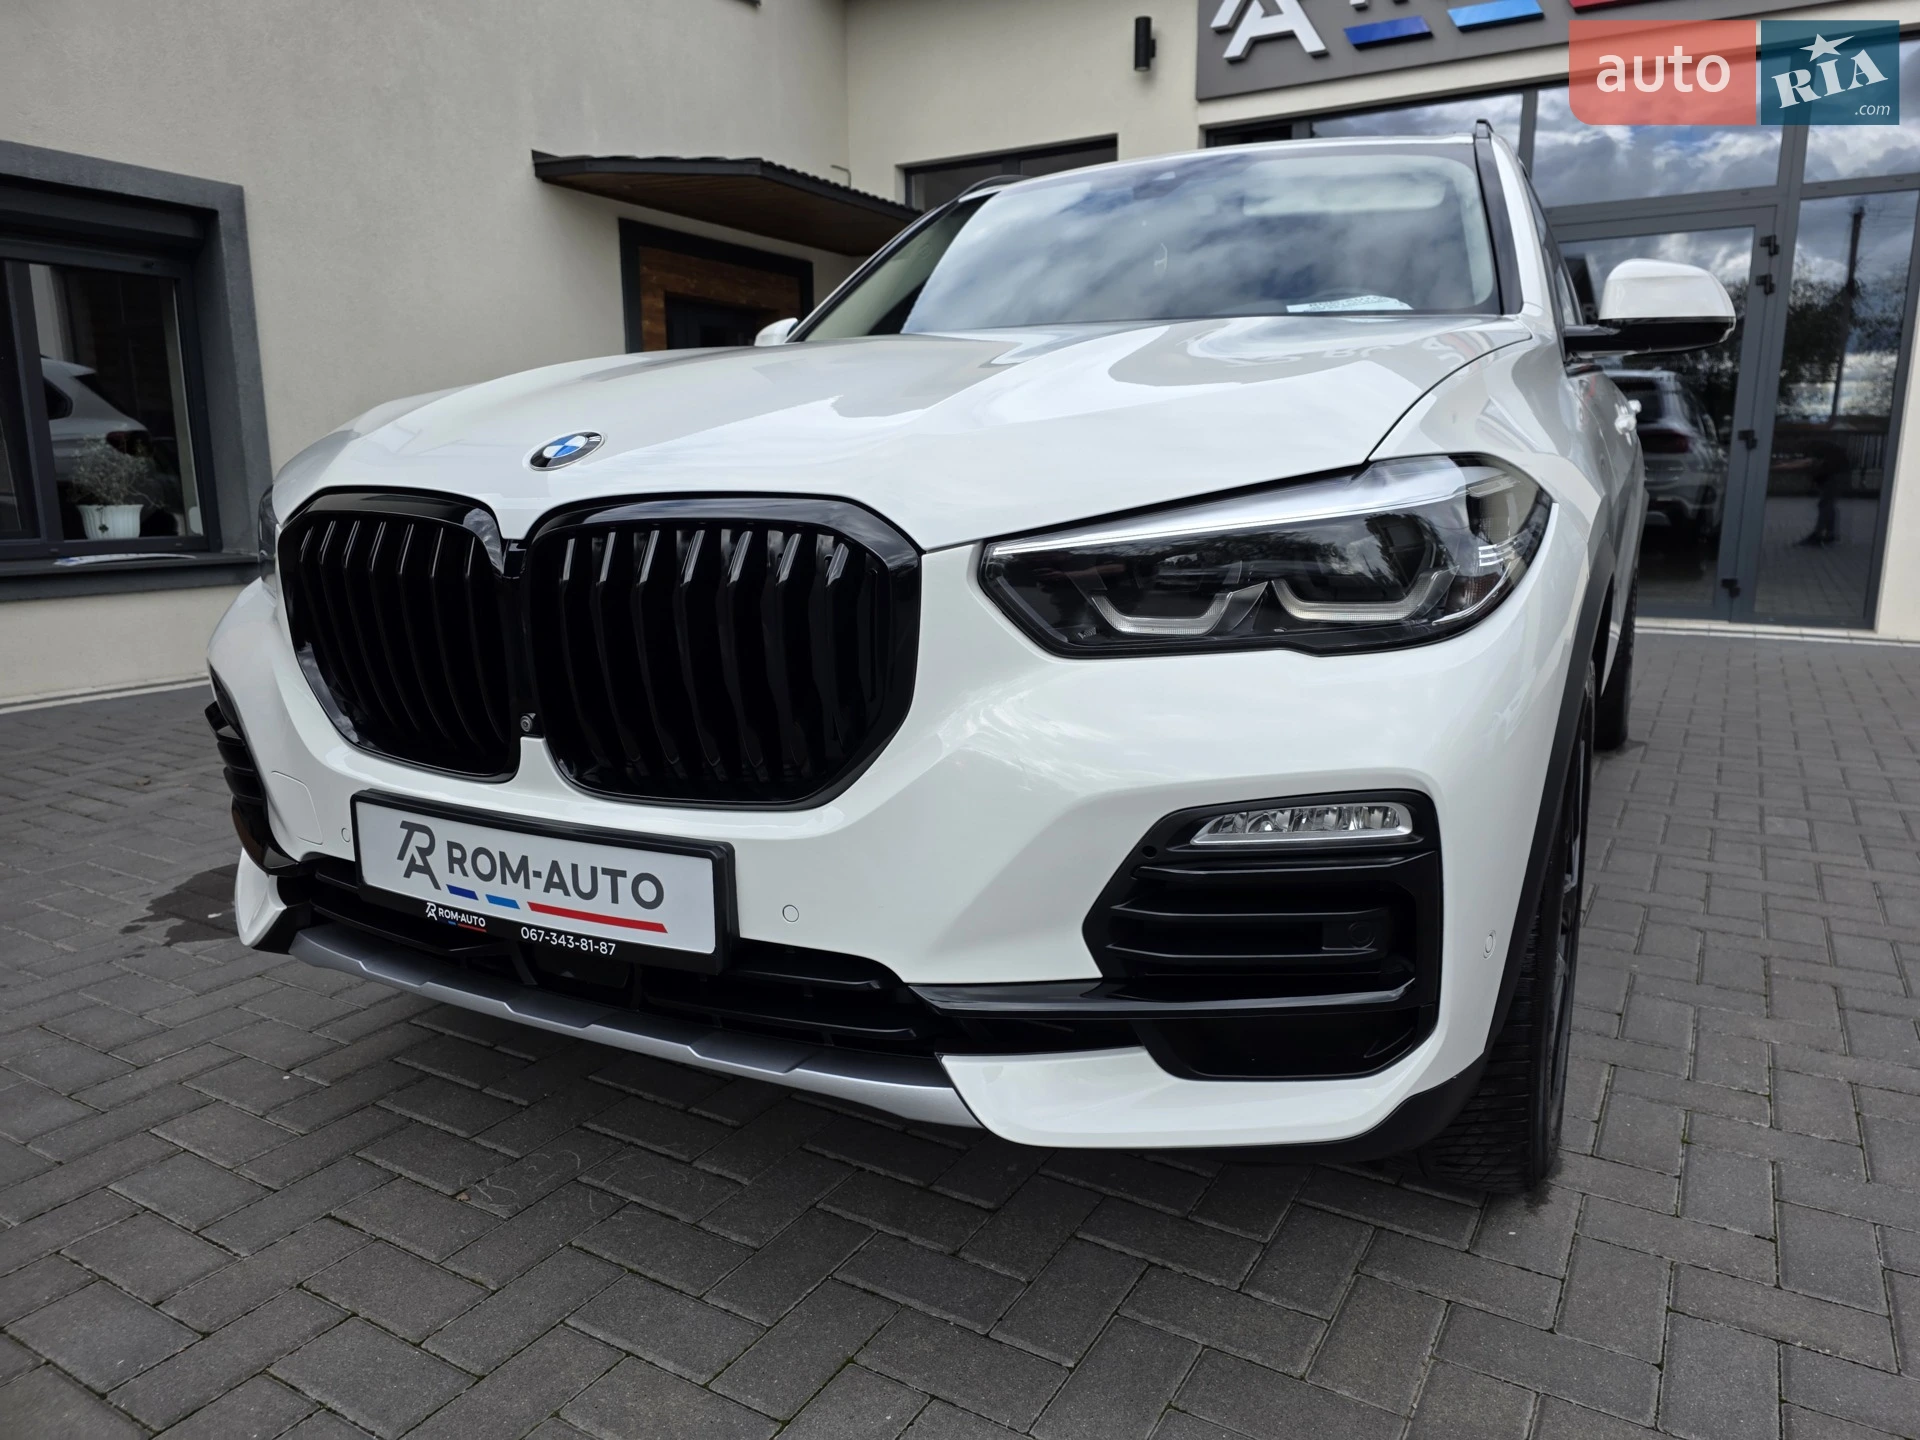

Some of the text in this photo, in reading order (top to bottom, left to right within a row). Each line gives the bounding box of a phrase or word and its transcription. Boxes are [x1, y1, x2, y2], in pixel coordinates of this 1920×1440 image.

[446, 840, 665, 910] ROM-AUTO
[438, 907, 486, 928] ROM-AUTO
[520, 926, 616, 956] 067-343-81-87
